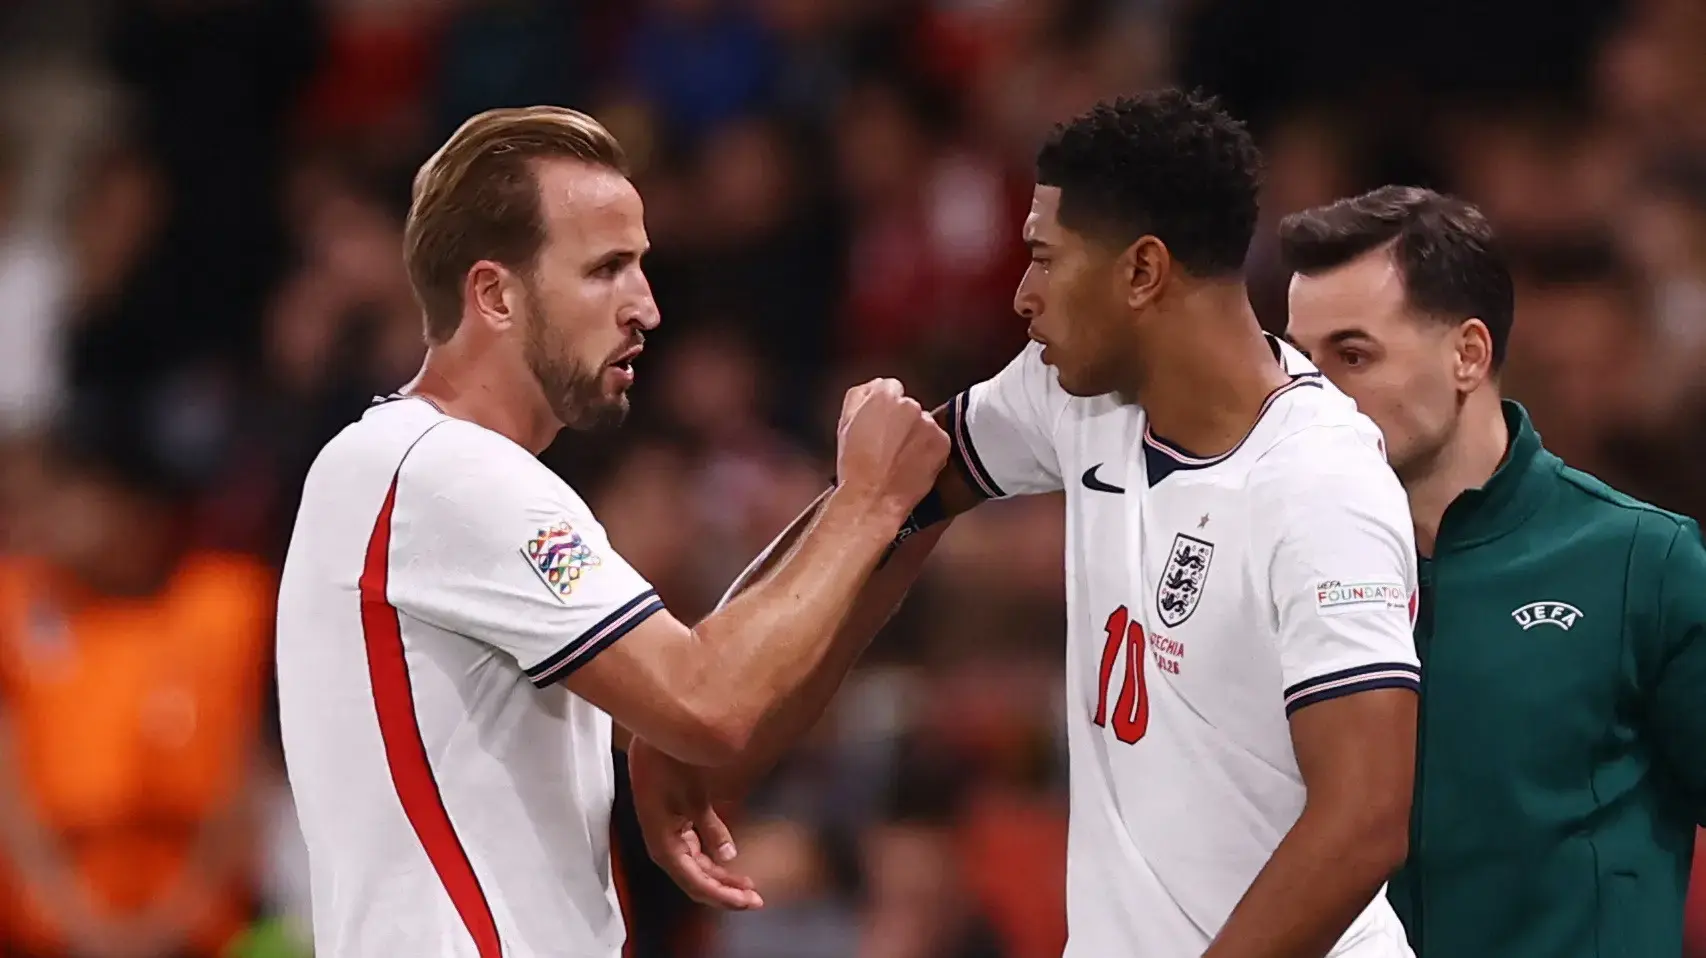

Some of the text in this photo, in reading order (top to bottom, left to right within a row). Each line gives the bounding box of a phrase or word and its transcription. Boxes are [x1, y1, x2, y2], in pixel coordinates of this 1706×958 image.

[1317, 580, 1341, 590] UEFA
[1515, 605, 1576, 627] UEFA
[1094, 604, 1148, 745] 10
